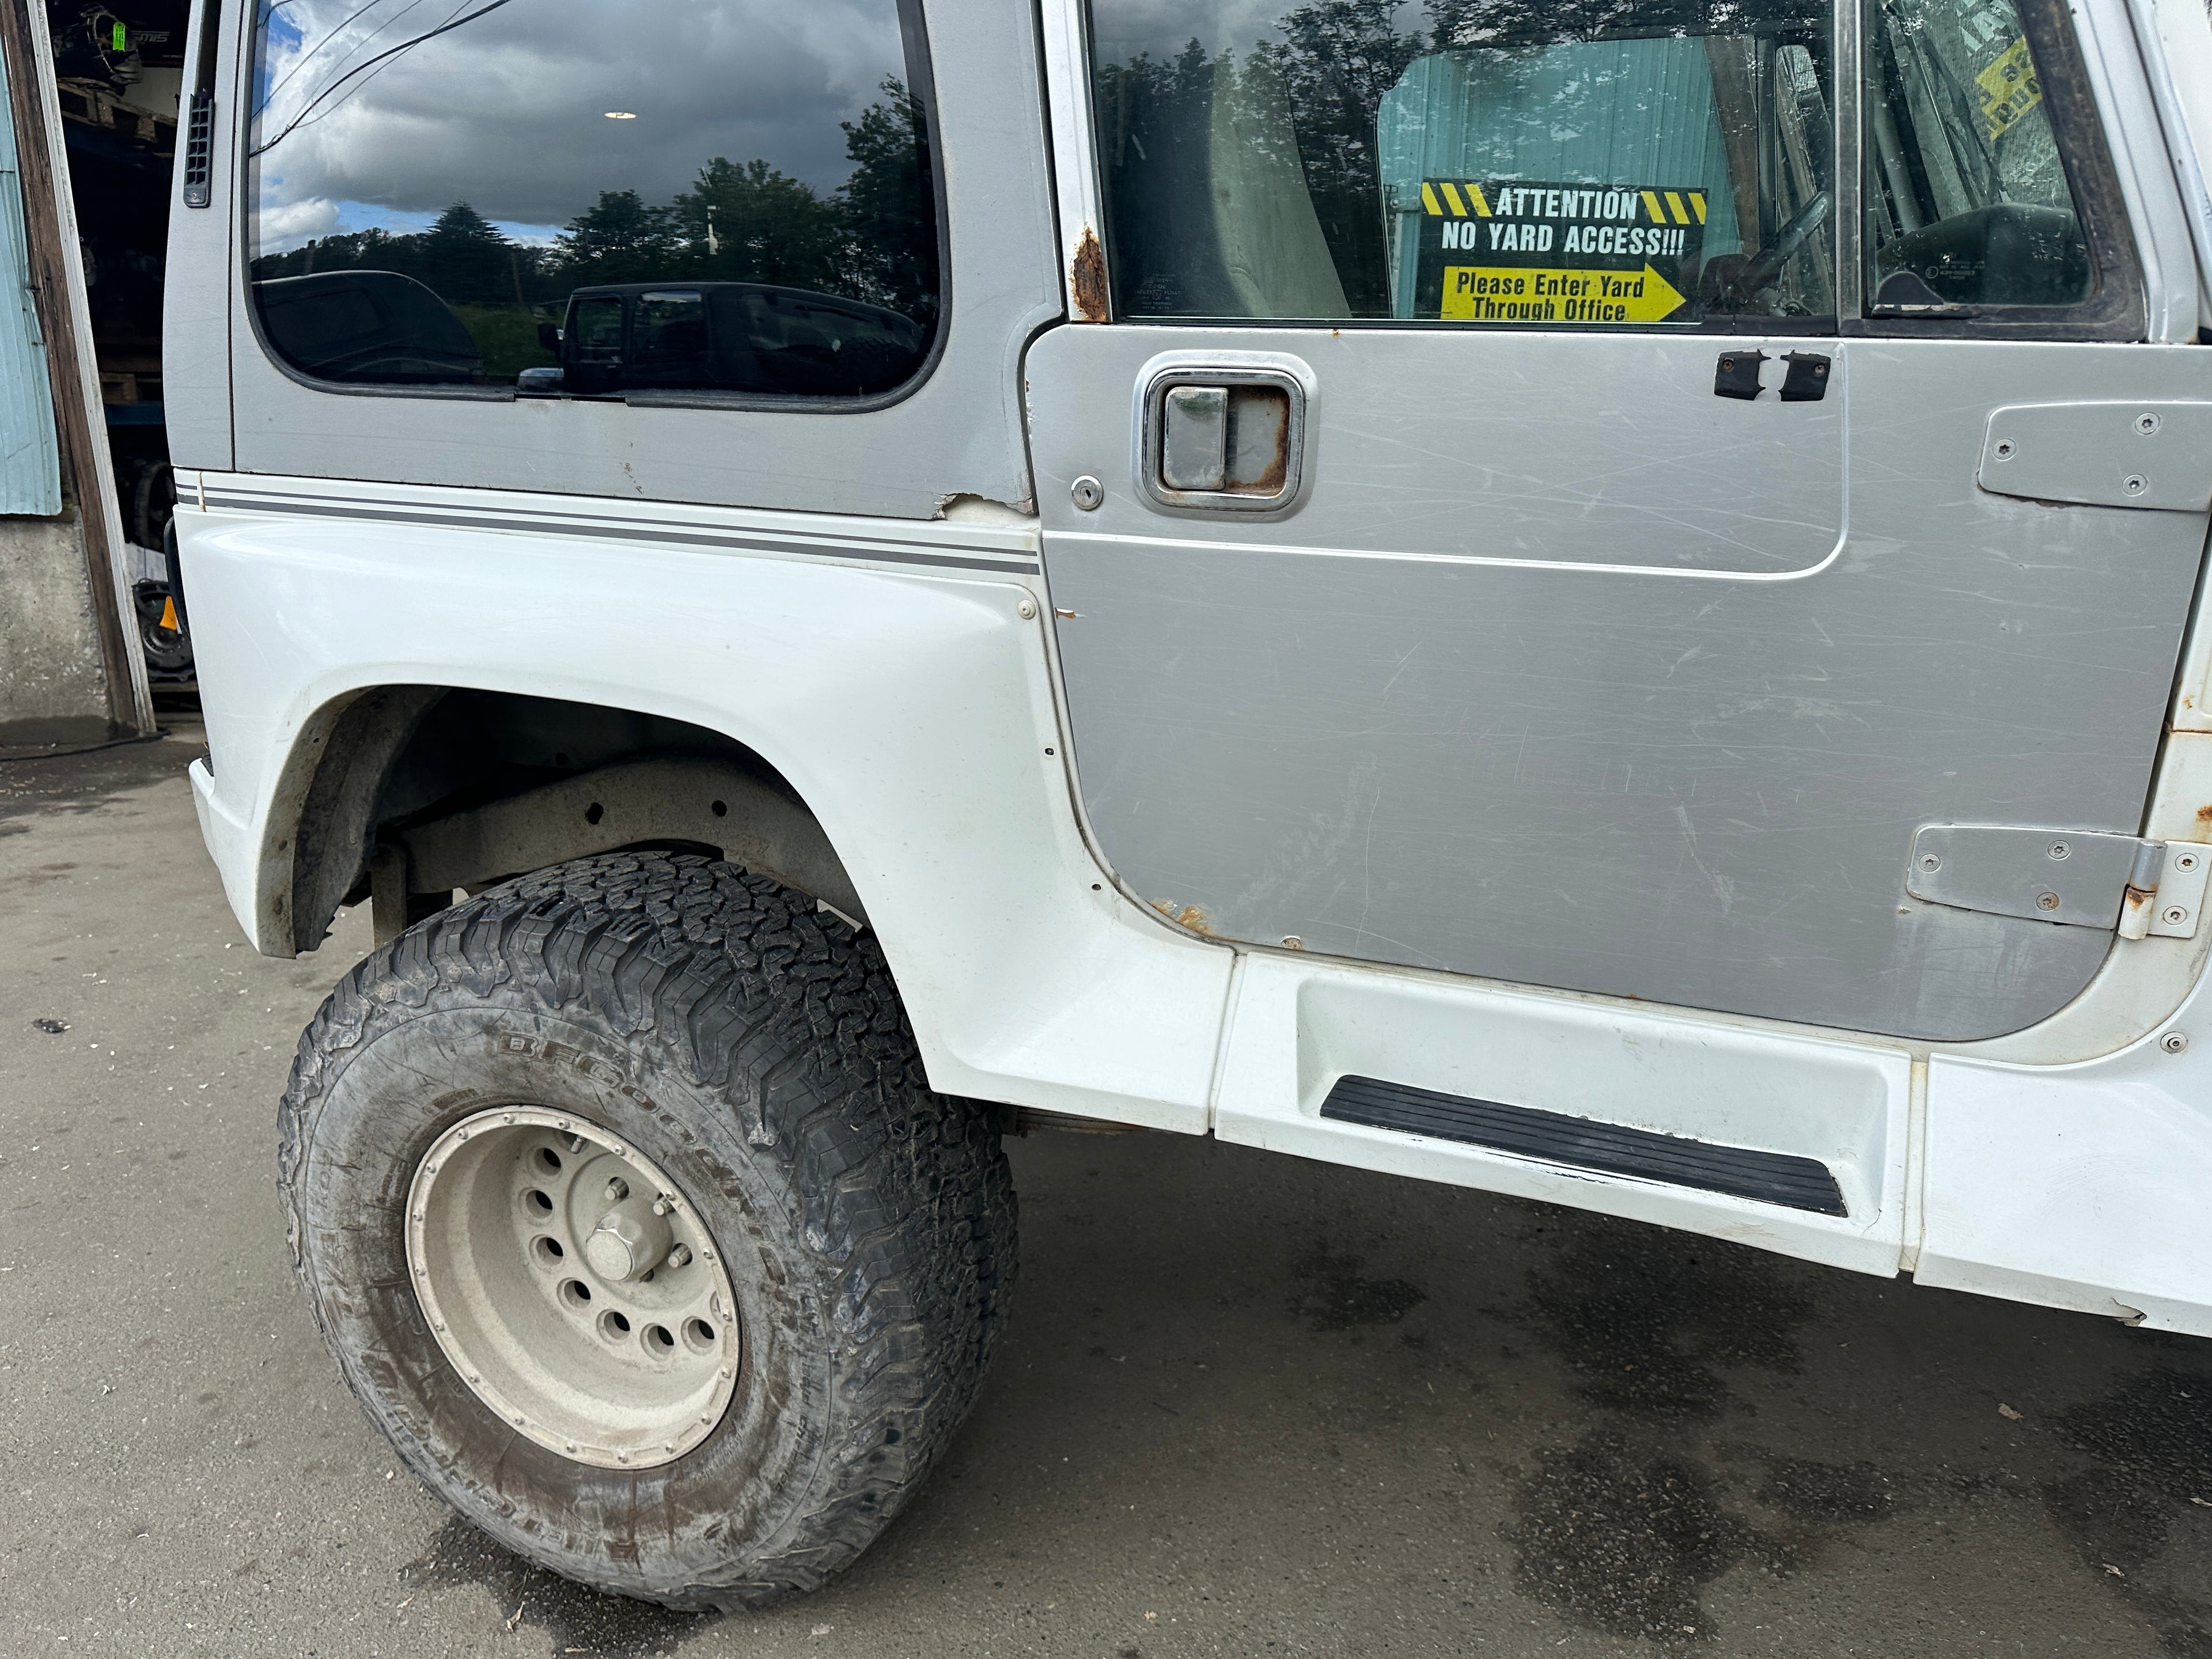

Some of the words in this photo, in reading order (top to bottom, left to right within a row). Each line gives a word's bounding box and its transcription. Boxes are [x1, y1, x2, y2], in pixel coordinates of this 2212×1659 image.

[1495, 187, 1638, 219] ATTENTION
[1442, 221, 1476, 250] NO
[1489, 222, 1554, 252] YARD
[1563, 225, 1685, 256] ACCESS!!!
[1457, 272, 1525, 296] Please
[1535, 274, 1590, 297] Enter
[1600, 275, 1645, 298] Yard
[1473, 297, 1555, 321] Through
[1565, 298, 1626, 321] Office
